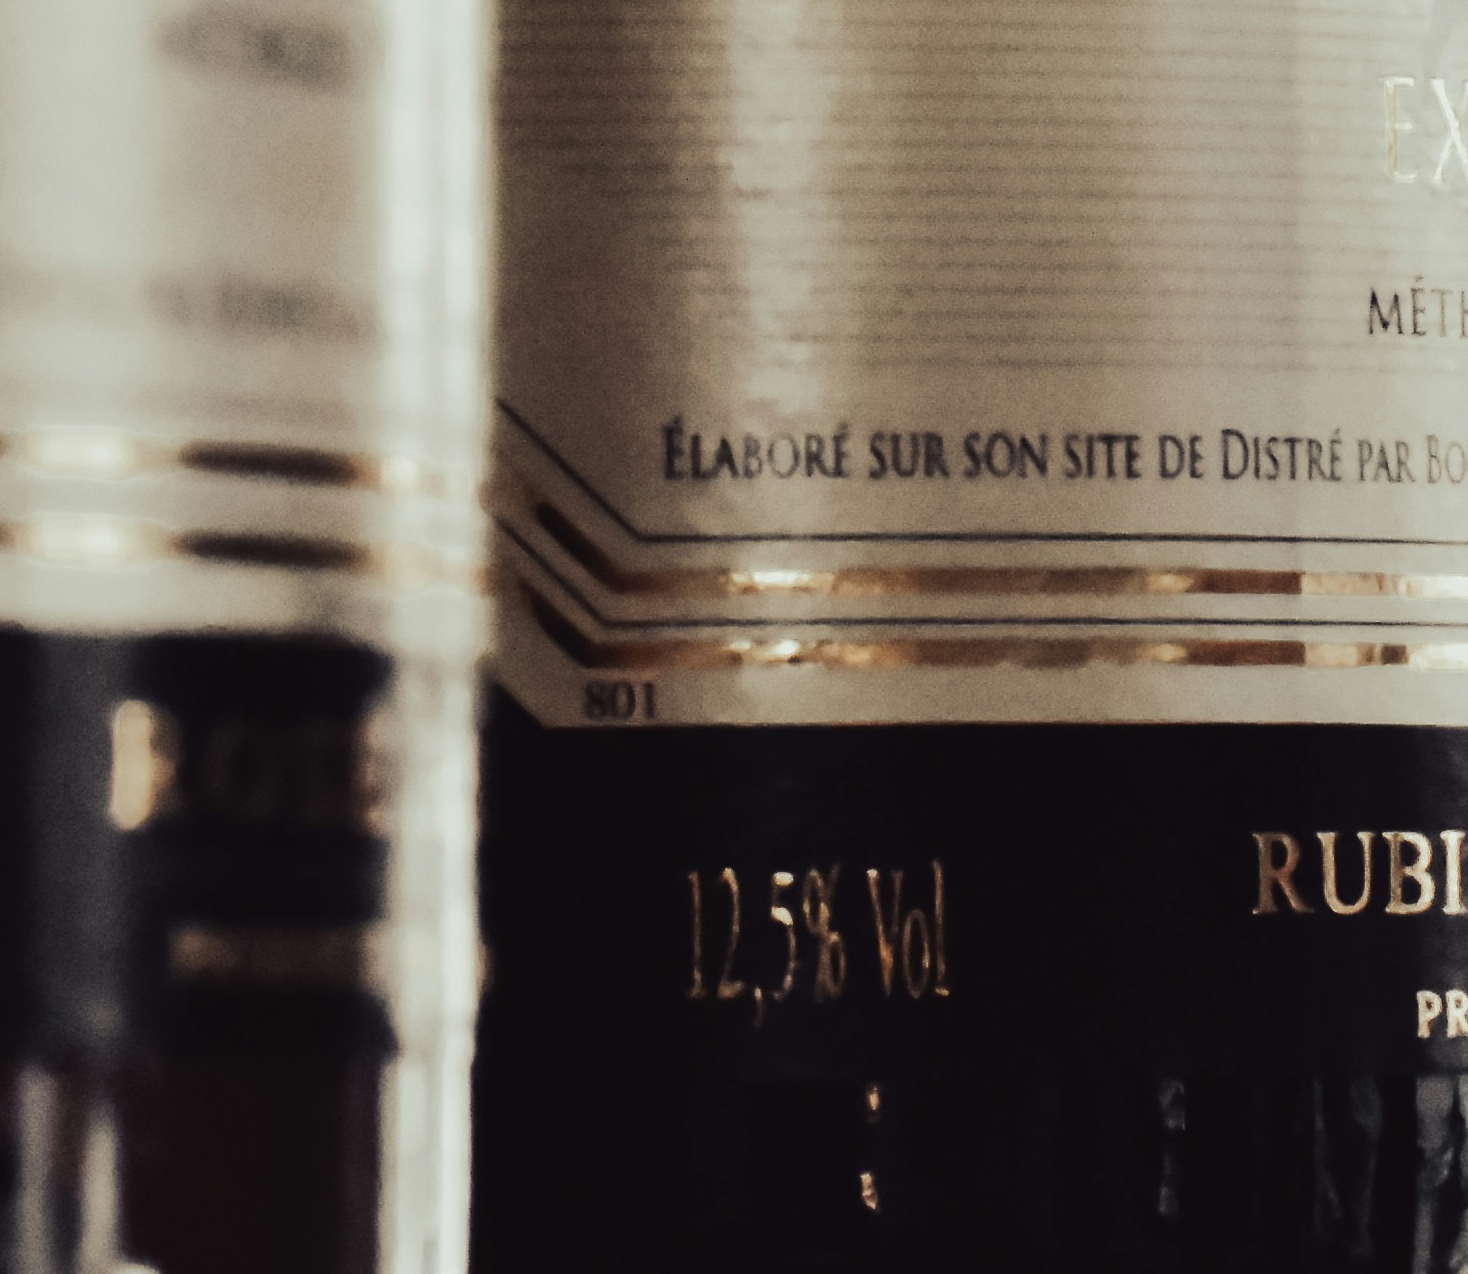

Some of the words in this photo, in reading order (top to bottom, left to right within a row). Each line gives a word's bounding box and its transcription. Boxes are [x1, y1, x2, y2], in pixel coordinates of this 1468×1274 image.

[868, 430, 949, 480] SUR
[963, 430, 1049, 480] SON
[1063, 431, 1142, 480] SITE
[1158, 433, 1205, 480] DE
[1357, 438, 1417, 485] PAR
[687, 861, 847, 1028] 12,5%
[865, 858, 950, 999] Vol
